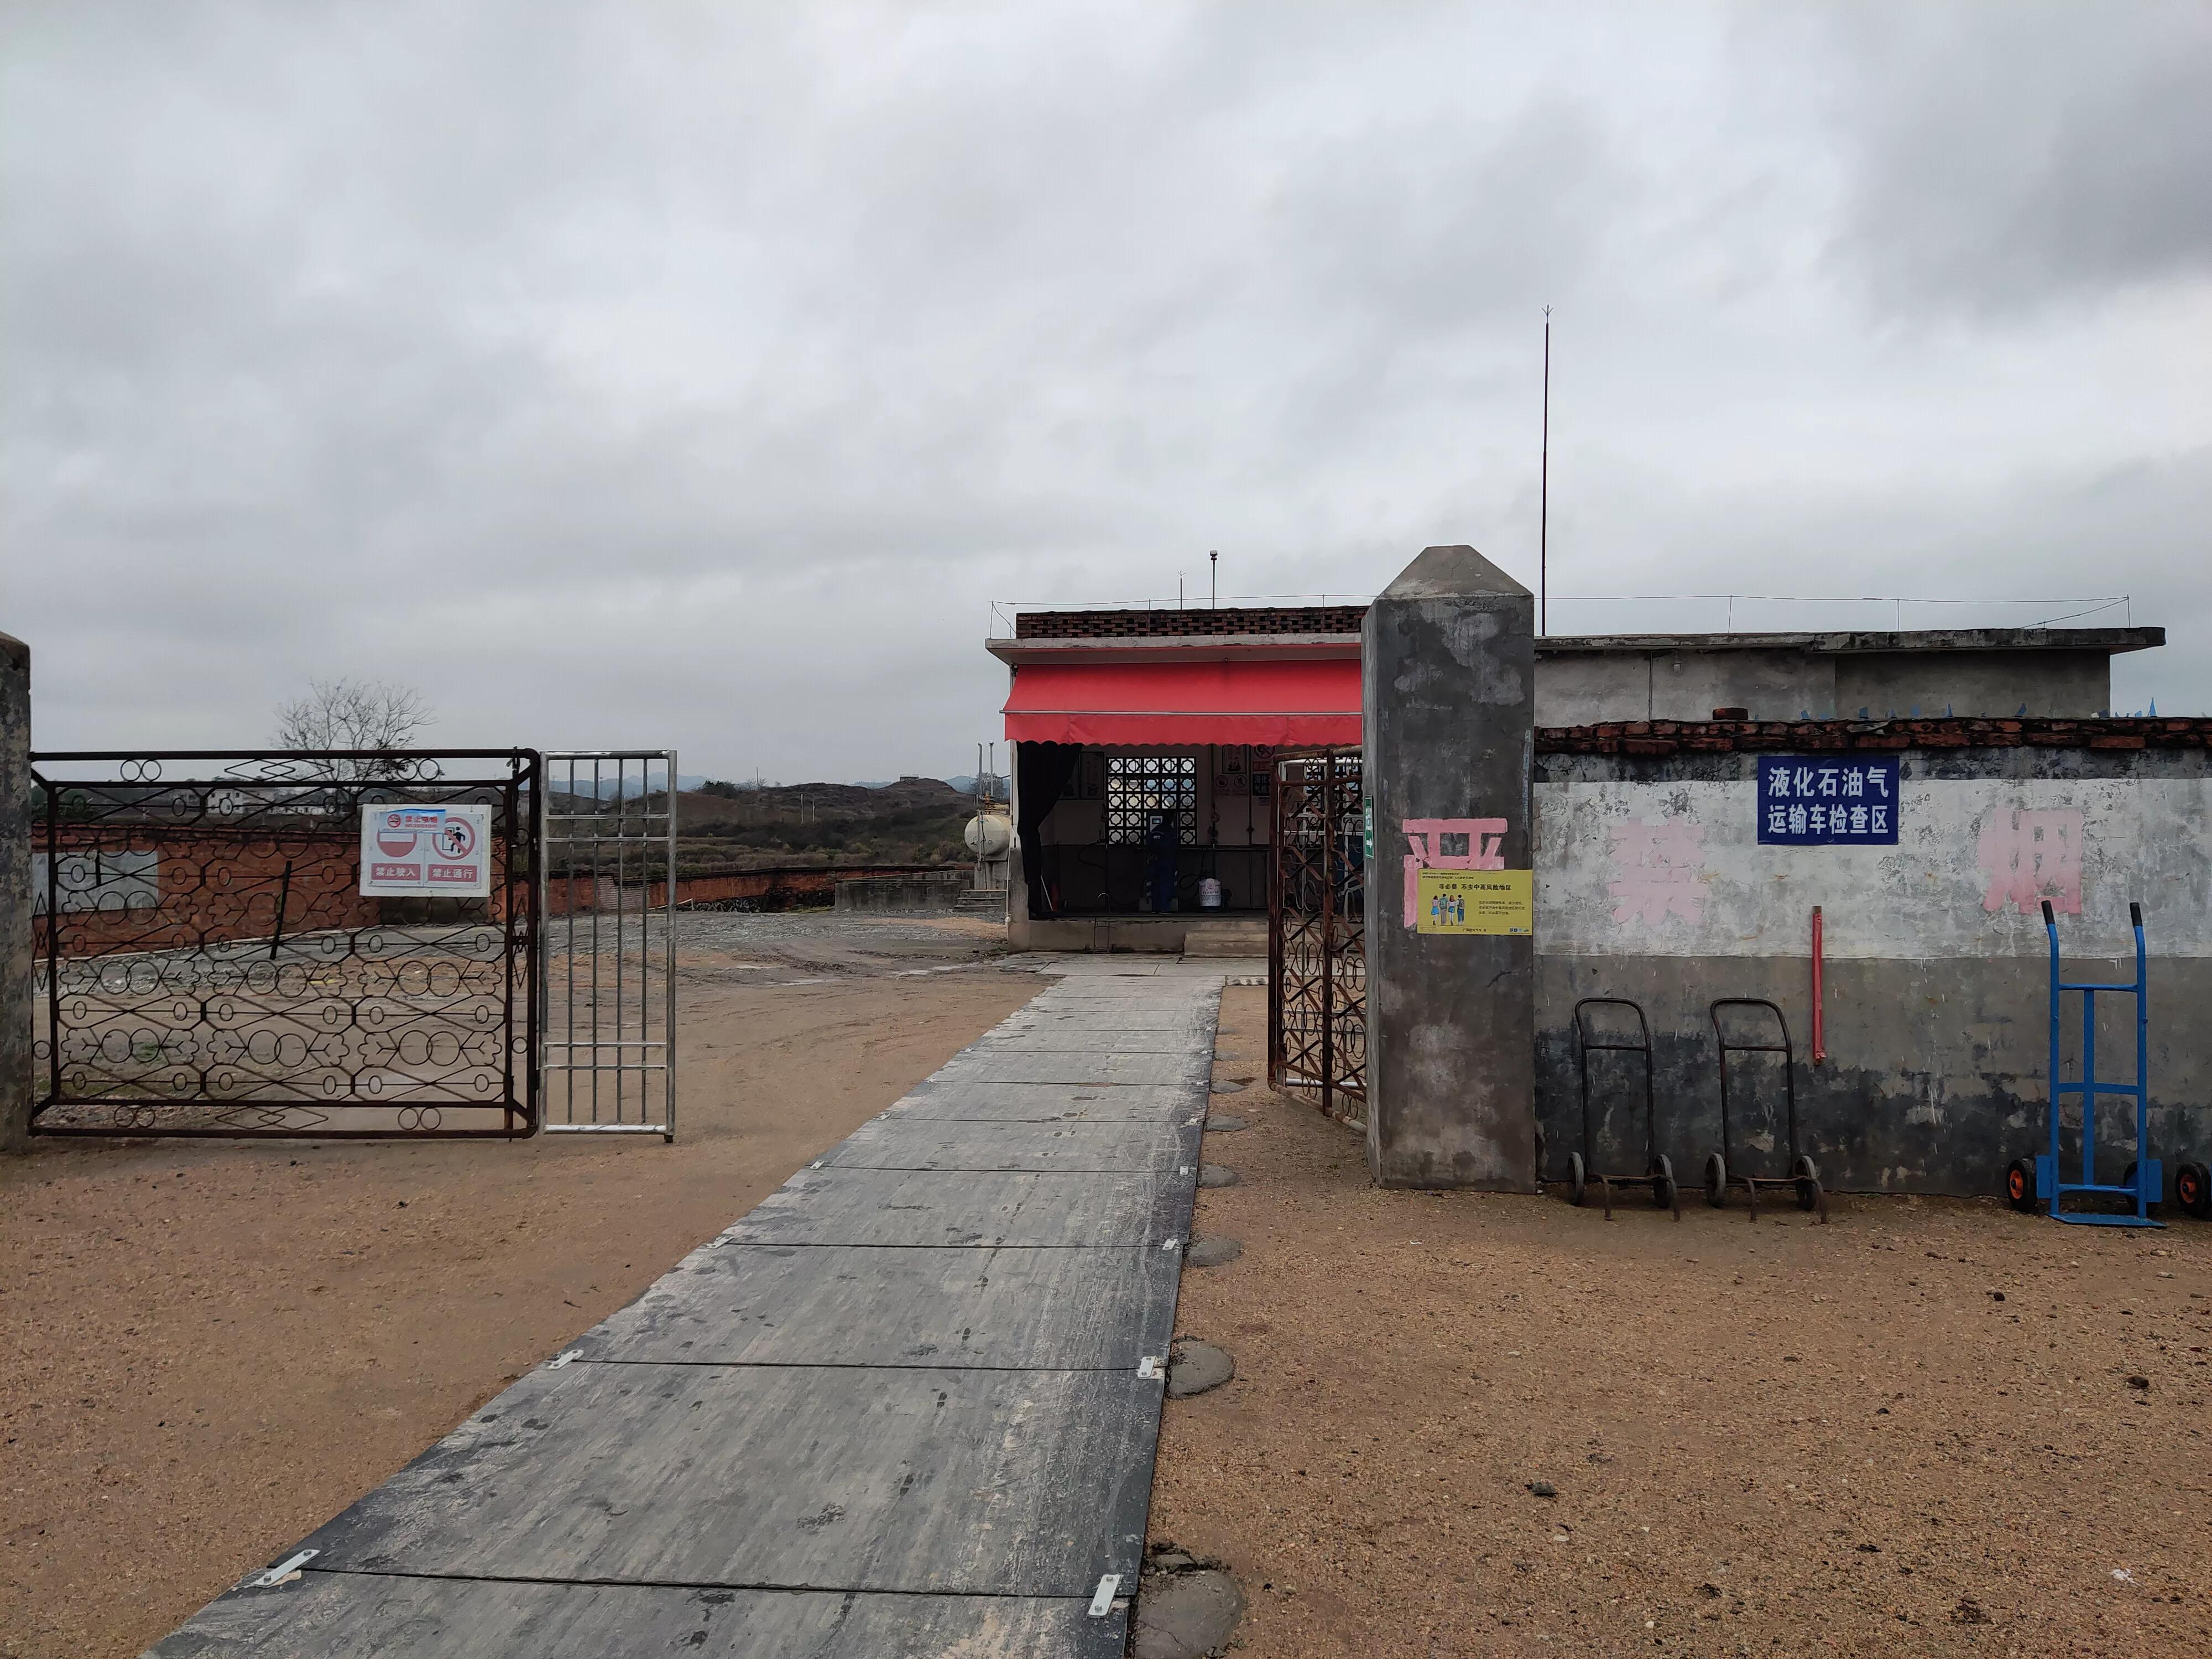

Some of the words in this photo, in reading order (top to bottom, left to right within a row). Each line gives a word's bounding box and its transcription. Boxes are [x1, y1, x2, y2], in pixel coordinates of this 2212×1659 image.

[1767, 766, 1890, 798] 液化石油气
[1767, 804, 1889, 835] 运输车检查区
[375, 866, 416, 877] 禁止驶入
[432, 868, 474, 879] 禁止通行
